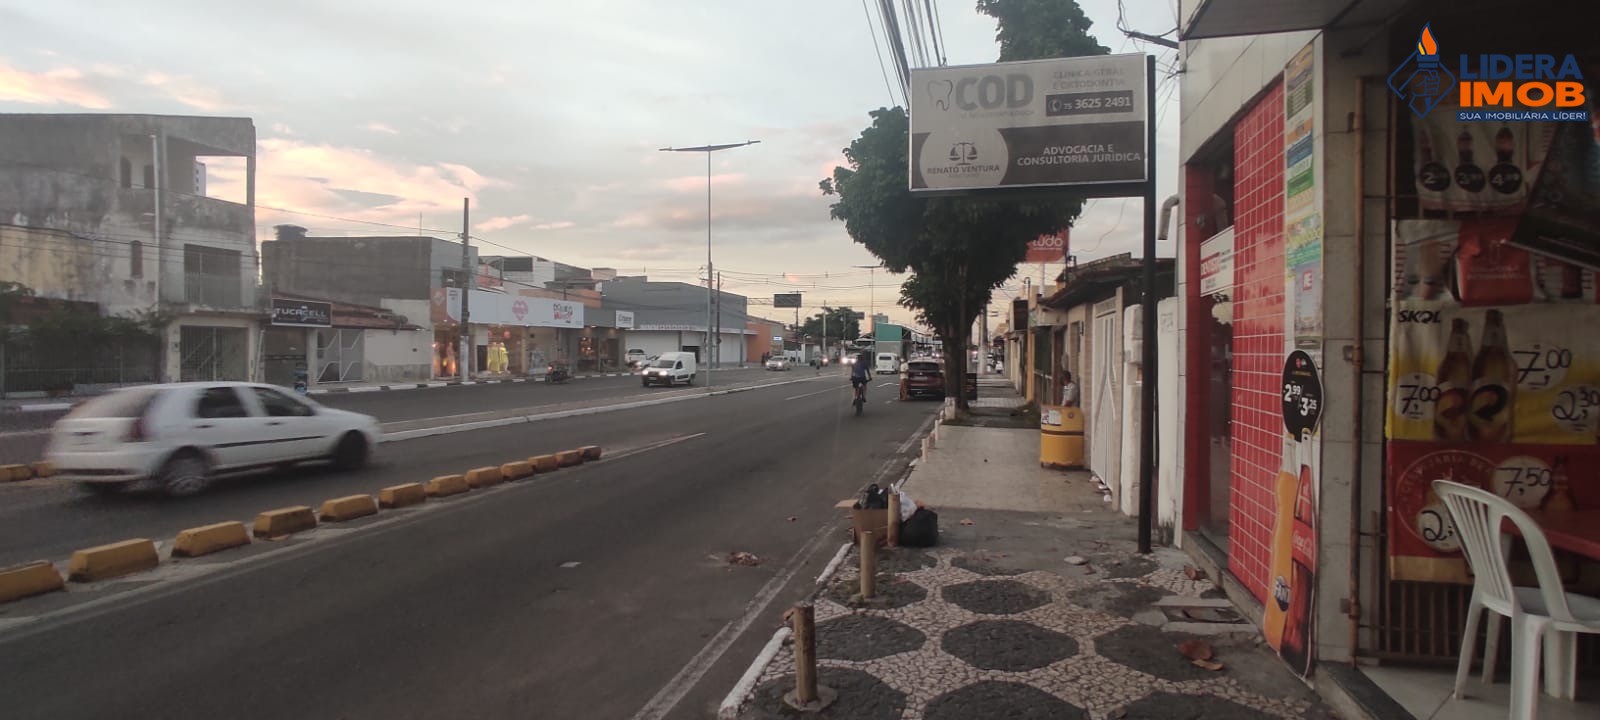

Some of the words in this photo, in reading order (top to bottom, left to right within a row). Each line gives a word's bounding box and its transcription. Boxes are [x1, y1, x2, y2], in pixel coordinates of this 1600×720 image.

[956, 73, 1034, 111] COD
[1075, 99, 1101, 110] 3625
[1105, 96, 1131, 108] 2491
[1043, 144, 1104, 155] ADVOCACIA
[1106, 143, 1113, 153] E
[1017, 154, 1089, 167] CONSULTORIA
[1092, 150, 1141, 163] JURÍDICA
[927, 165, 959, 175] RENATO
[961, 163, 1000, 174] VENTURA
[1398, 310, 1441, 324] SKOL
